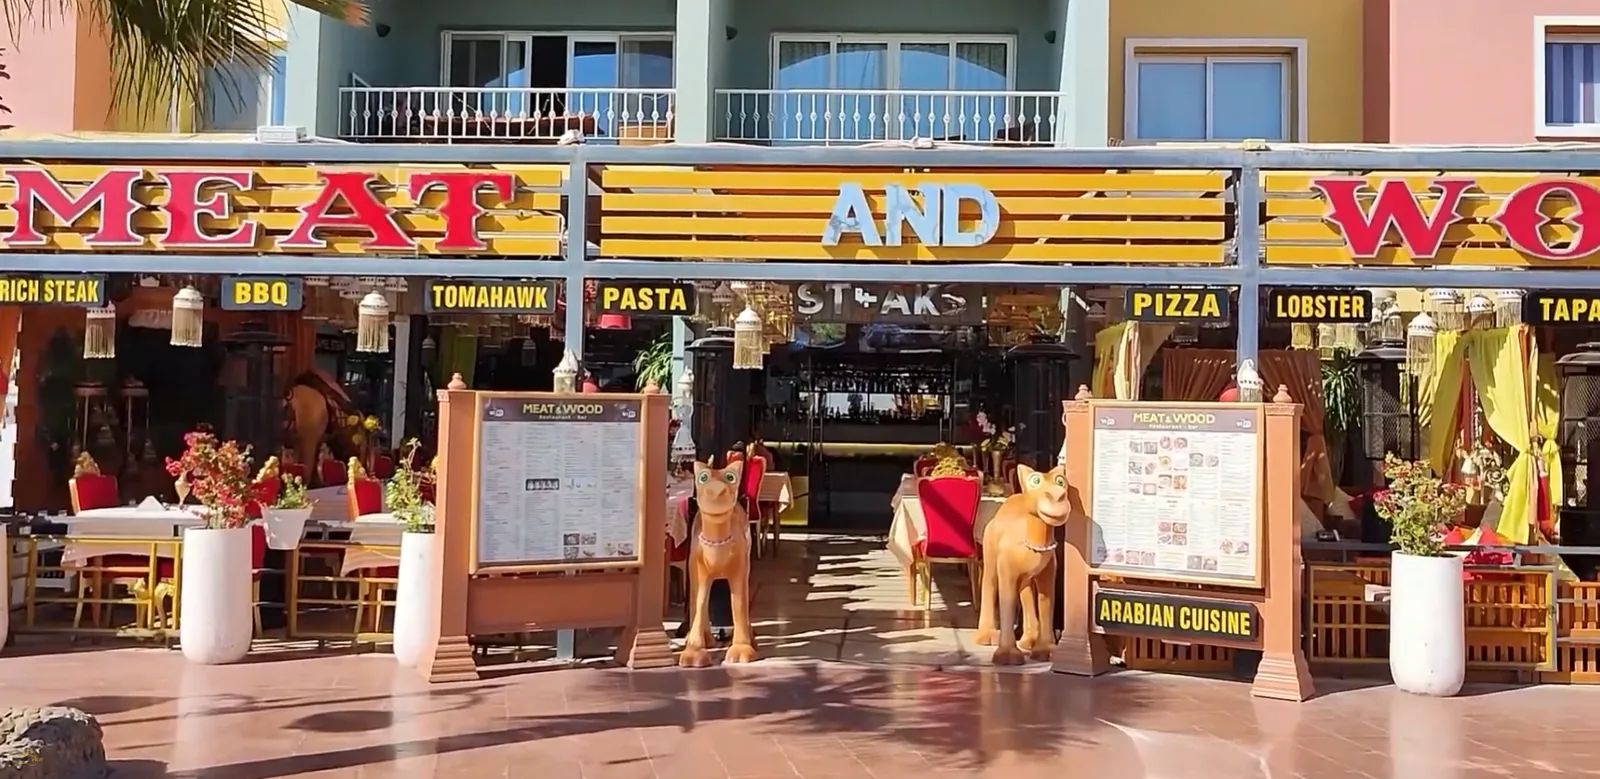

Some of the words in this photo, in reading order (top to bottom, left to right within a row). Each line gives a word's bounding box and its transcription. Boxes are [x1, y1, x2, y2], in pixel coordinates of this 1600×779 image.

[2, 168, 516, 251] MEAT
[821, 182, 1000, 247] AND
[1309, 176, 1600, 260] WO
[0, 279, 39, 302] RICH
[44, 280, 99, 302] STEAK
[235, 282, 288, 307] BBQ
[432, 285, 548, 309] TOMAHAWK
[602, 287, 688, 311] PASTA
[1134, 292, 1221, 317] PIZZA
[1276, 295, 1365, 319] LOBSTER
[1539, 298, 1600, 322] TAPA
[1099, 599, 1175, 628] ARABIAN
[1179, 606, 1251, 636] CUISINE
